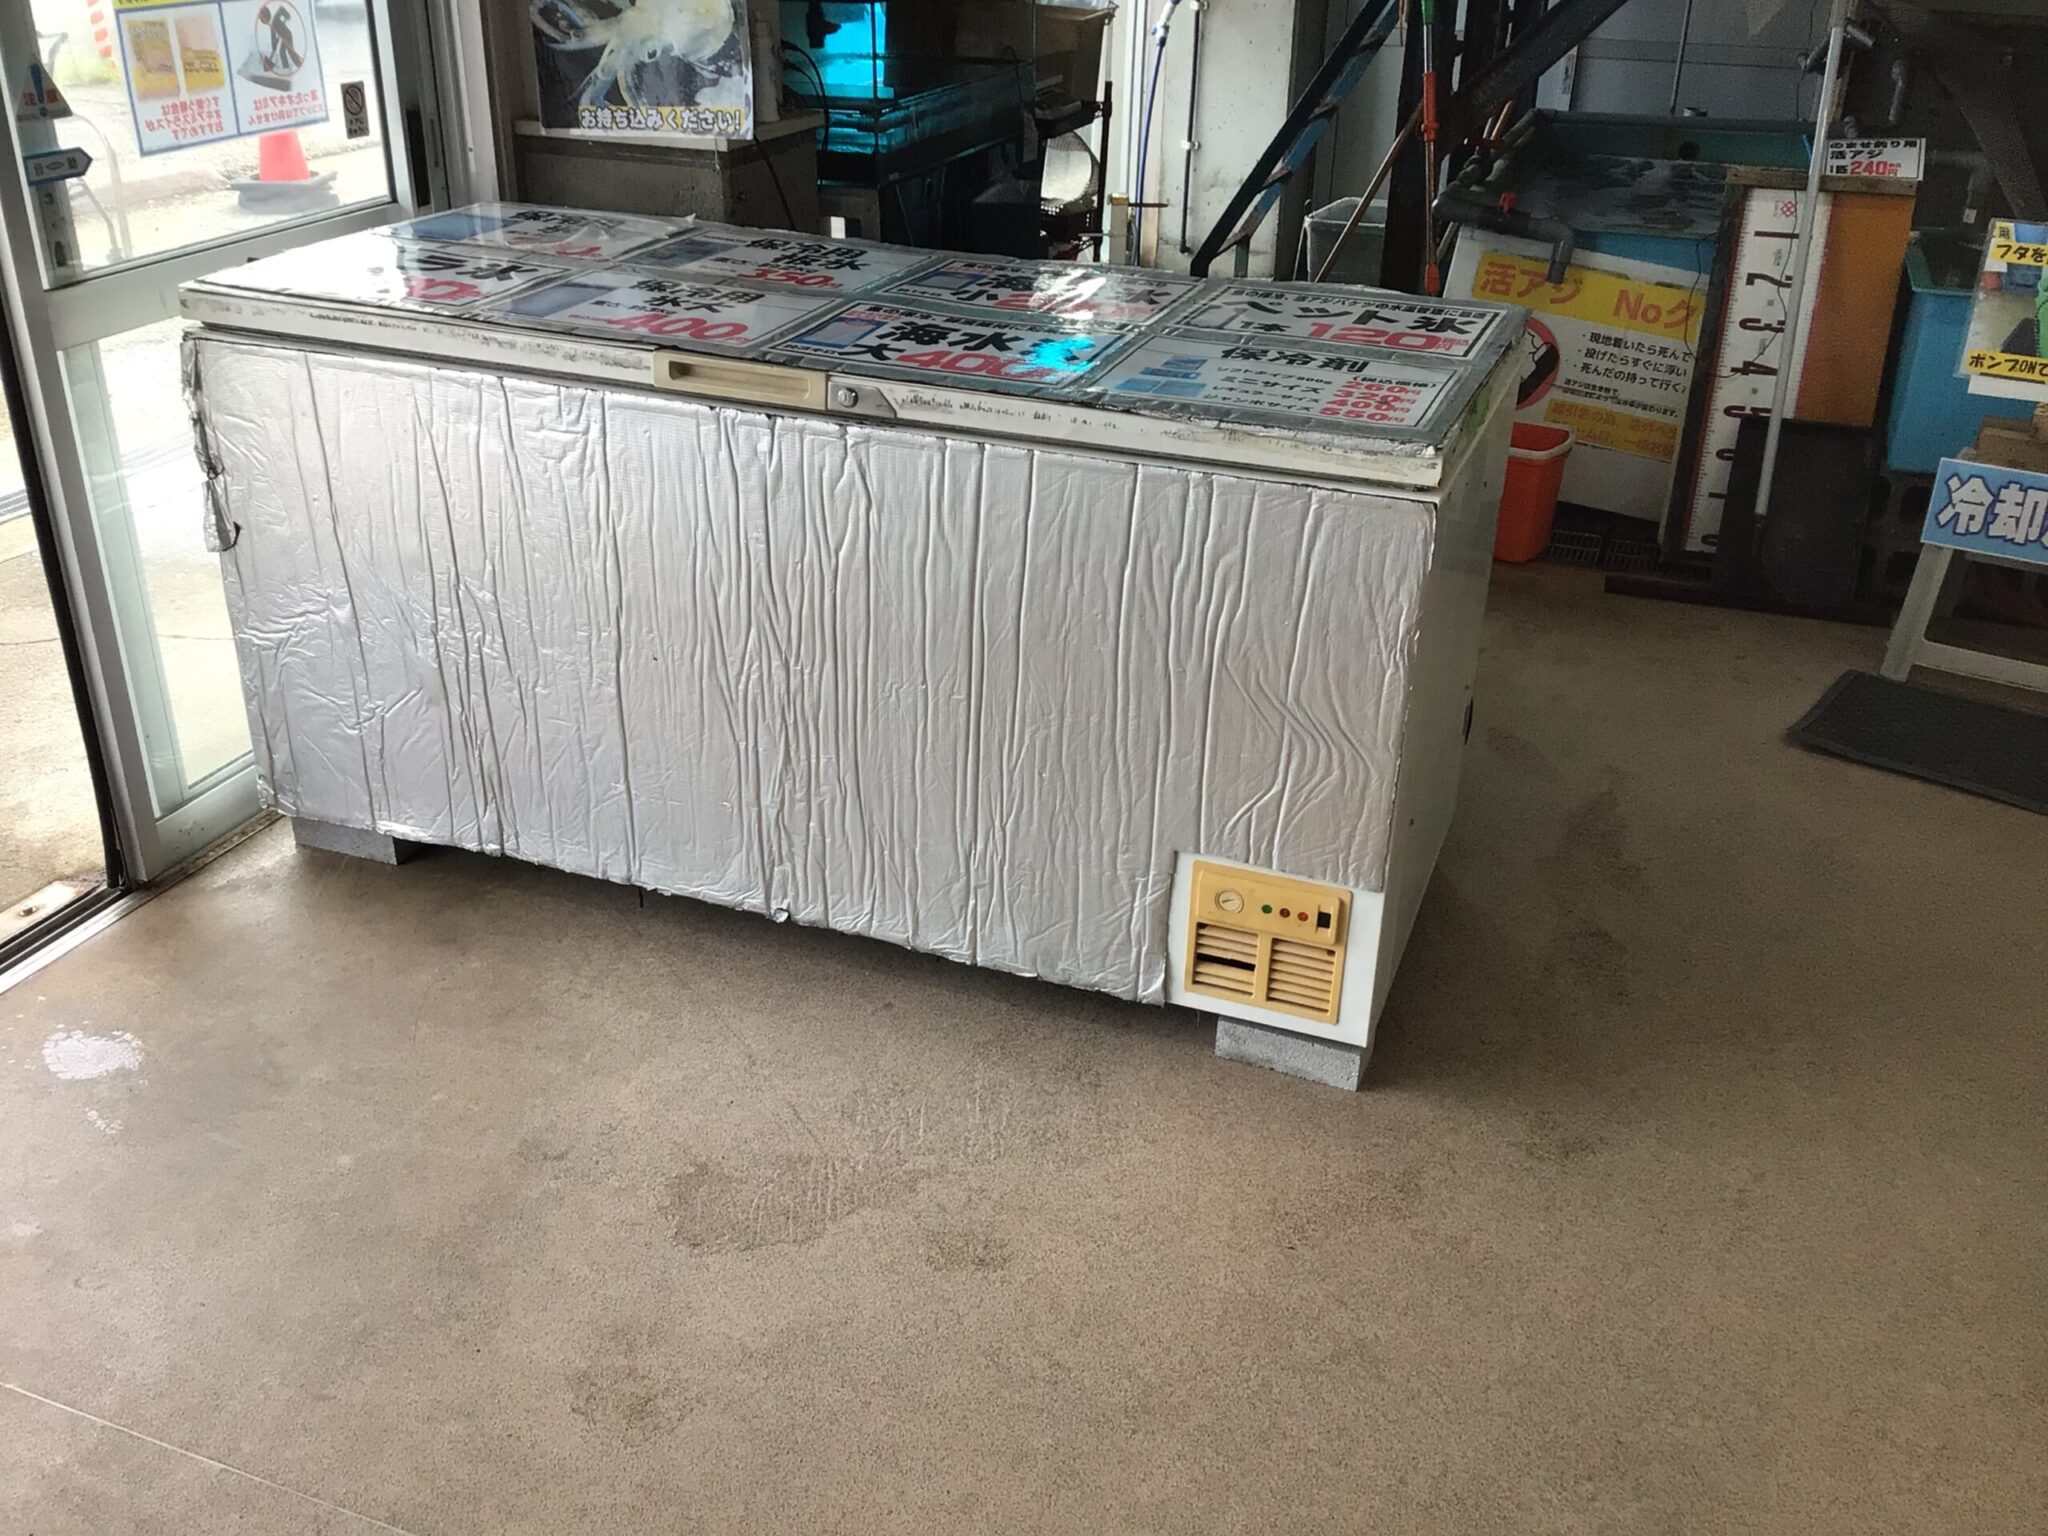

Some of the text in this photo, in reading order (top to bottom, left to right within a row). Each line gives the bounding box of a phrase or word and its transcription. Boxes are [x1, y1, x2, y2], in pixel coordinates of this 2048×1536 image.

[580, 107, 741, 130] お持ち込みください!
[1830, 140, 1917, 149] のませ釣り用
[1830, 149, 1884, 160] 活アジ
[746, 238, 867, 260] 保冷用
[1996, 244, 2048, 264] フタを
[630, 278, 765, 303] 保冷用
[976, 274, 1171, 305] 海氷
[1480, 260, 1583, 304] 活アジ
[644, 296, 734, 313] 氷大
[1222, 299, 1479, 335] ペット氷
[1239, 320, 1291, 334] 1本
[837, 343, 906, 361] 大
[1220, 346, 1370, 374] 保冷剤
[1219, 376, 1324, 394] ミニサイズ
[1937, 474, 2048, 545] 冷却
